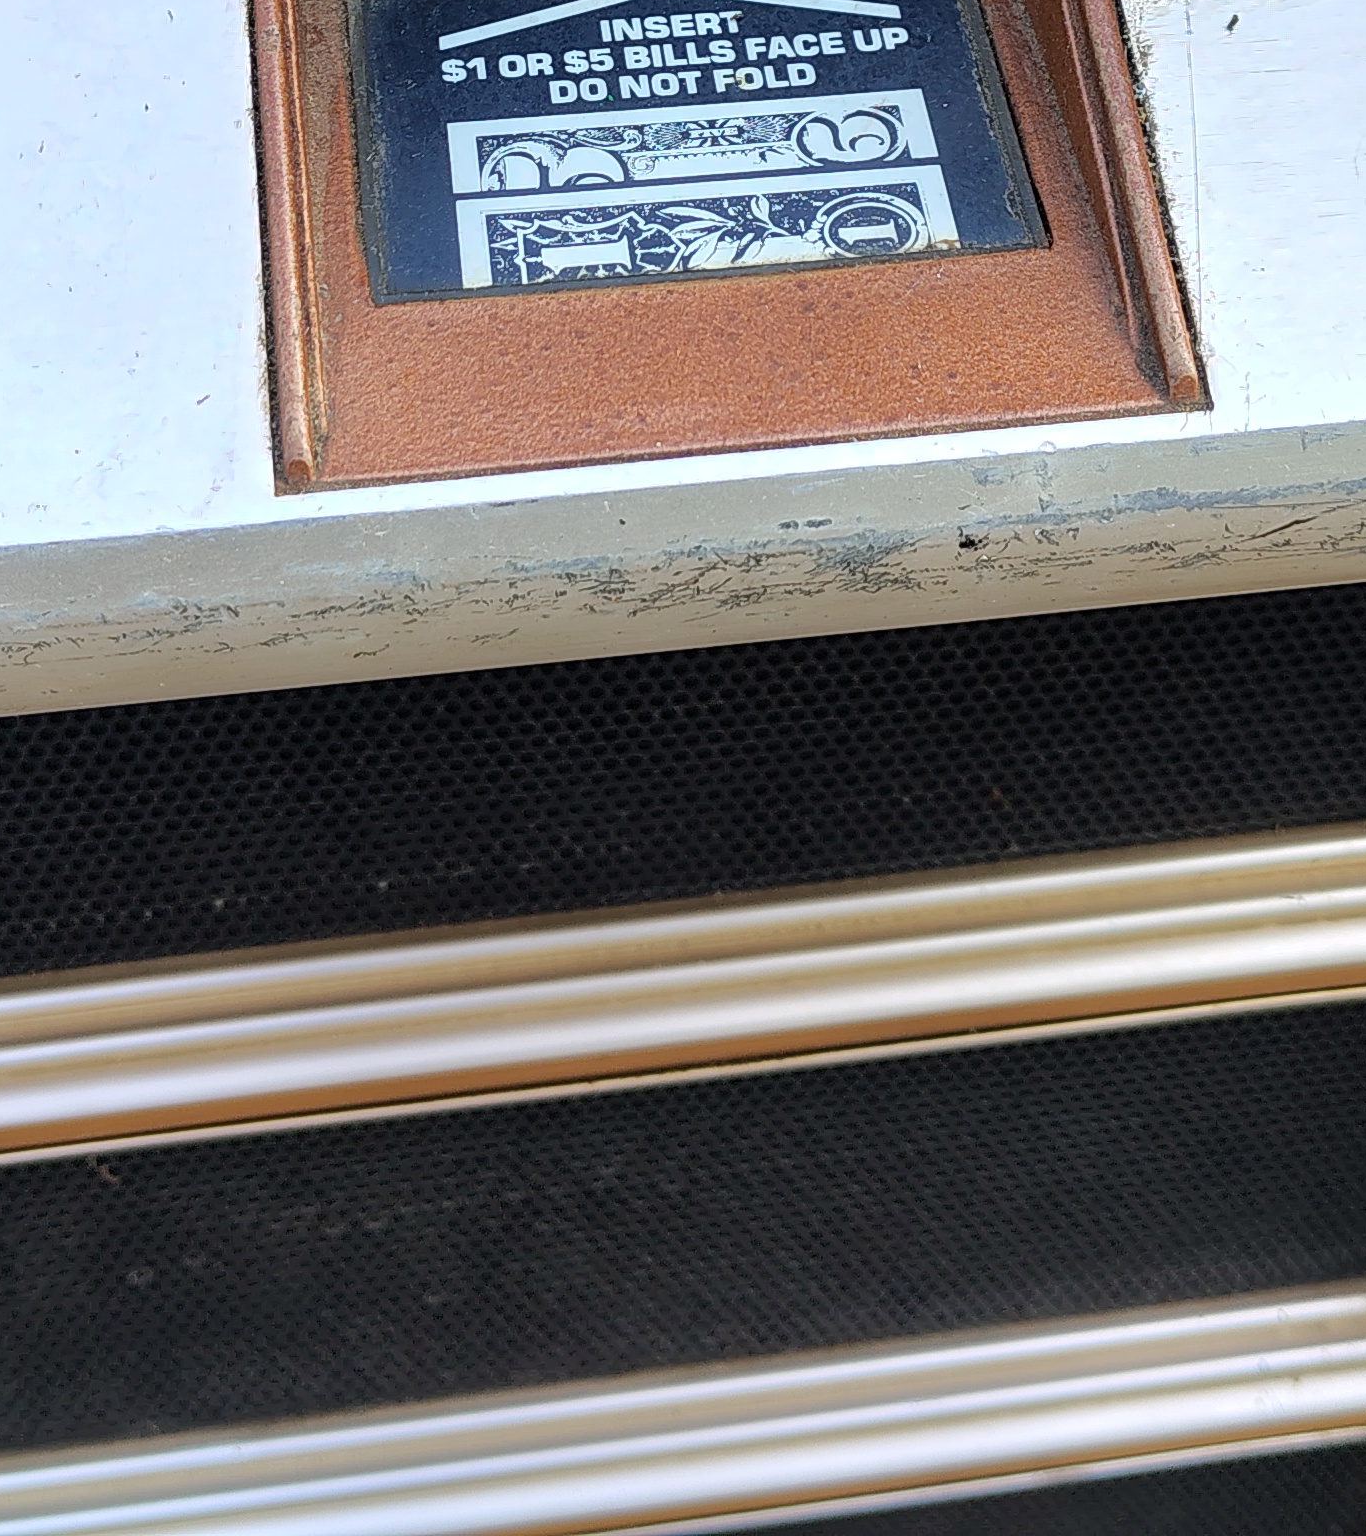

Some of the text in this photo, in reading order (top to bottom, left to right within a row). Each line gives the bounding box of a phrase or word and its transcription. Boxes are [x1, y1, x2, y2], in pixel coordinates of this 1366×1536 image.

[600, 10, 742, 42] INSERT
[442, 27, 909, 84] $1 OR $5 BILLS FACE UP
[549, 63, 817, 104] DO NOT FOLD
